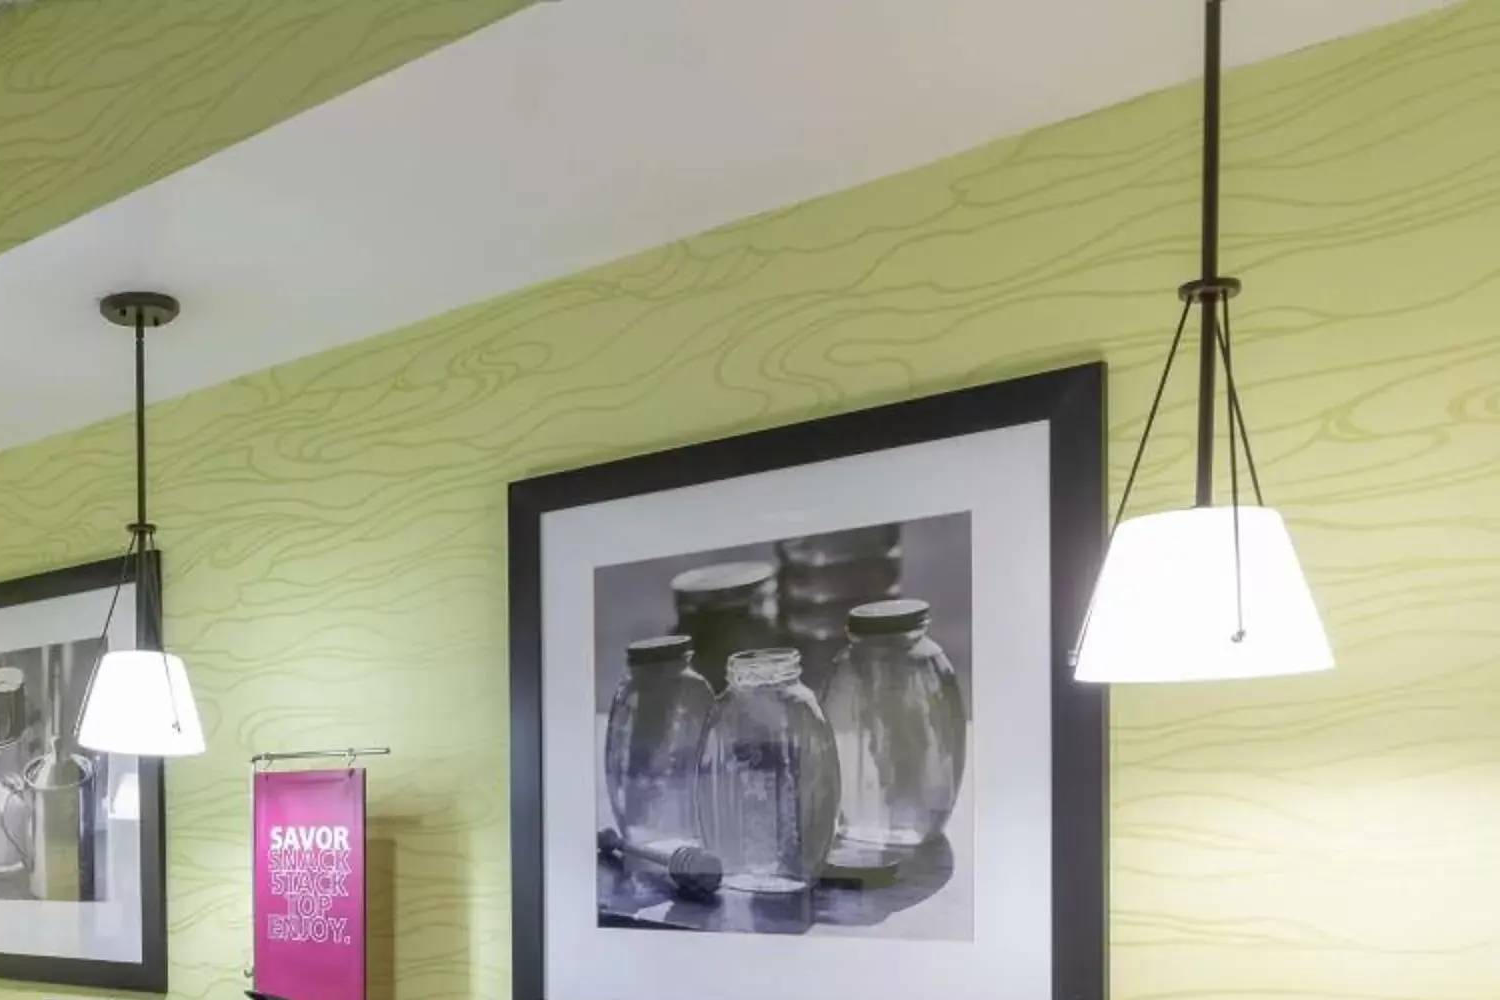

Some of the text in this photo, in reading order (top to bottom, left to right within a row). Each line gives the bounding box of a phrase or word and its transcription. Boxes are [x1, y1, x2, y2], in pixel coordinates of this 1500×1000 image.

[270, 826, 349, 850] SAVOR
[267, 848, 352, 872] SNACK
[270, 870, 349, 896] STACK
[284, 894, 332, 917] TOP
[266, 914, 351, 944] ENJOY.
